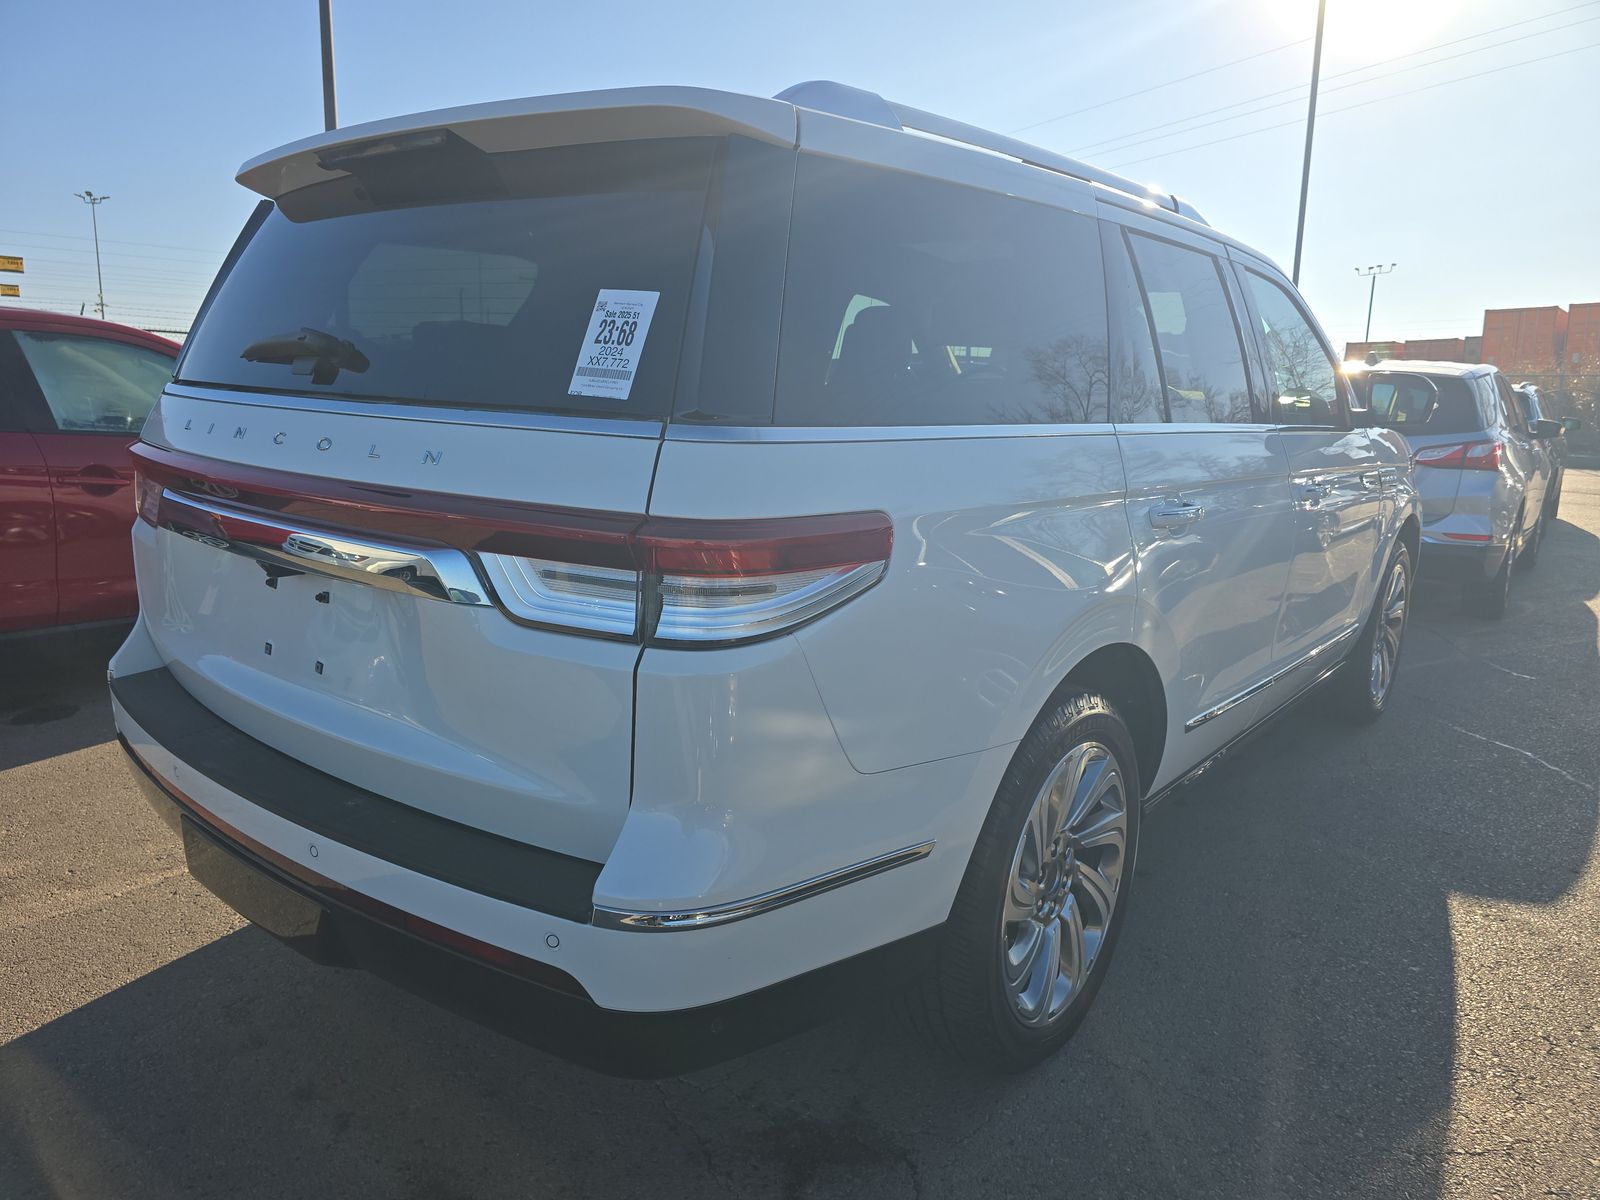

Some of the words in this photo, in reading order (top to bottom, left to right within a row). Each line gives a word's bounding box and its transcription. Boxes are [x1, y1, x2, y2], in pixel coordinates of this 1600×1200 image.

[604, 310, 617, 318] Sale
[617, 311, 632, 319] 2025
[632, 312, 640, 320] 51
[594, 319, 638, 347] 23:68
[598, 346, 624, 357] 2024
[184, 419, 443, 466] LINCOLN
